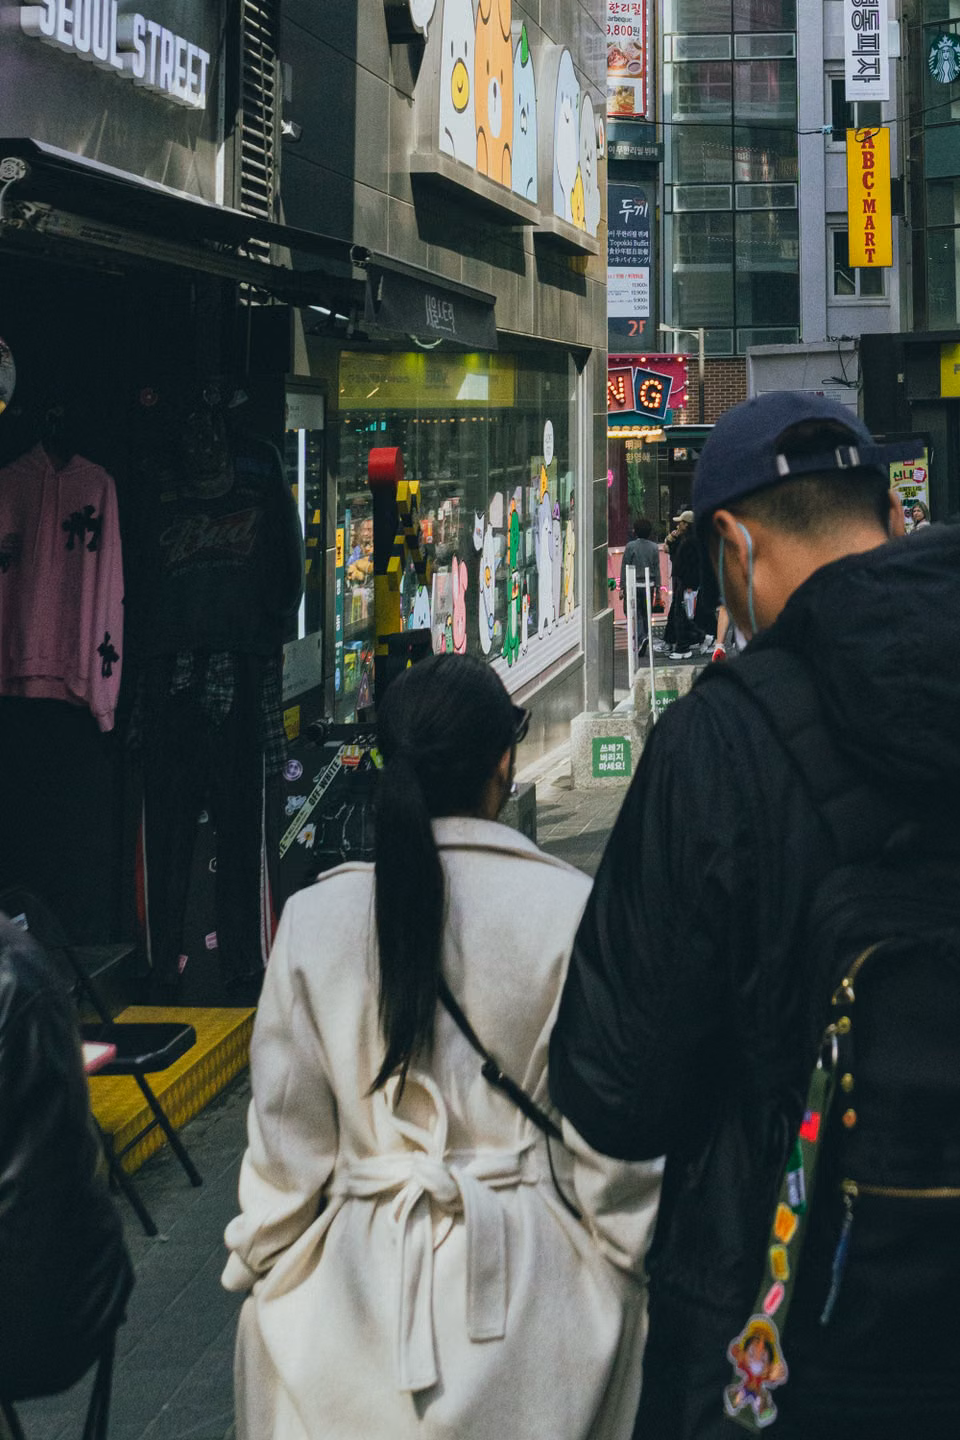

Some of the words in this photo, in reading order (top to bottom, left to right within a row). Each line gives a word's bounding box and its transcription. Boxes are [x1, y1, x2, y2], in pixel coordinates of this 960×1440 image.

[132, 12, 210, 111] STREET
[860, 130, 877, 264] ABC-MART
[619, 198, 649, 224] 두끼
[599, 743, 624, 753] 쓰레기
[599, 752, 624, 762] 버리지
[598, 761, 626, 771] 마세요!
[308, 758, 341, 807] OFF-WHITE
